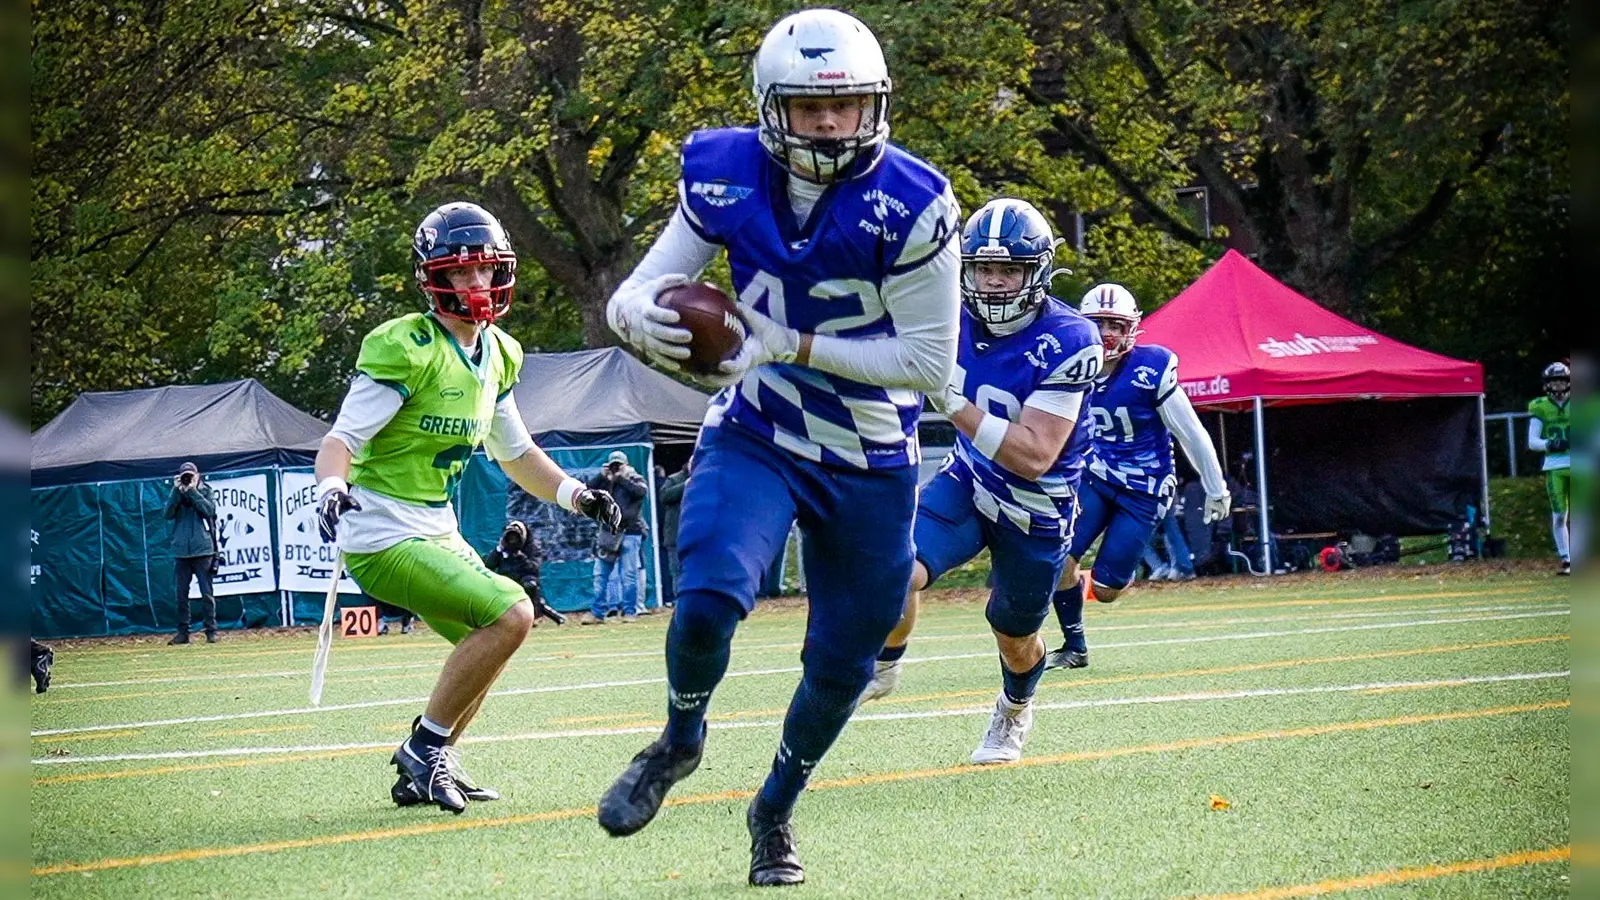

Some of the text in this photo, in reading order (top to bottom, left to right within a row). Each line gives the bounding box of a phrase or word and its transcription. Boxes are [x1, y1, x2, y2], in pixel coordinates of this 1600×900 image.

[739, 269, 886, 337] 42
[1065, 355, 1098, 383] 40
[1089, 406, 1135, 442] 21
[214, 488, 266, 518] RFORCE
[285, 484, 317, 516] CHEE
[285, 543, 339, 562] BTC-CL
[344, 609, 372, 637] 20
